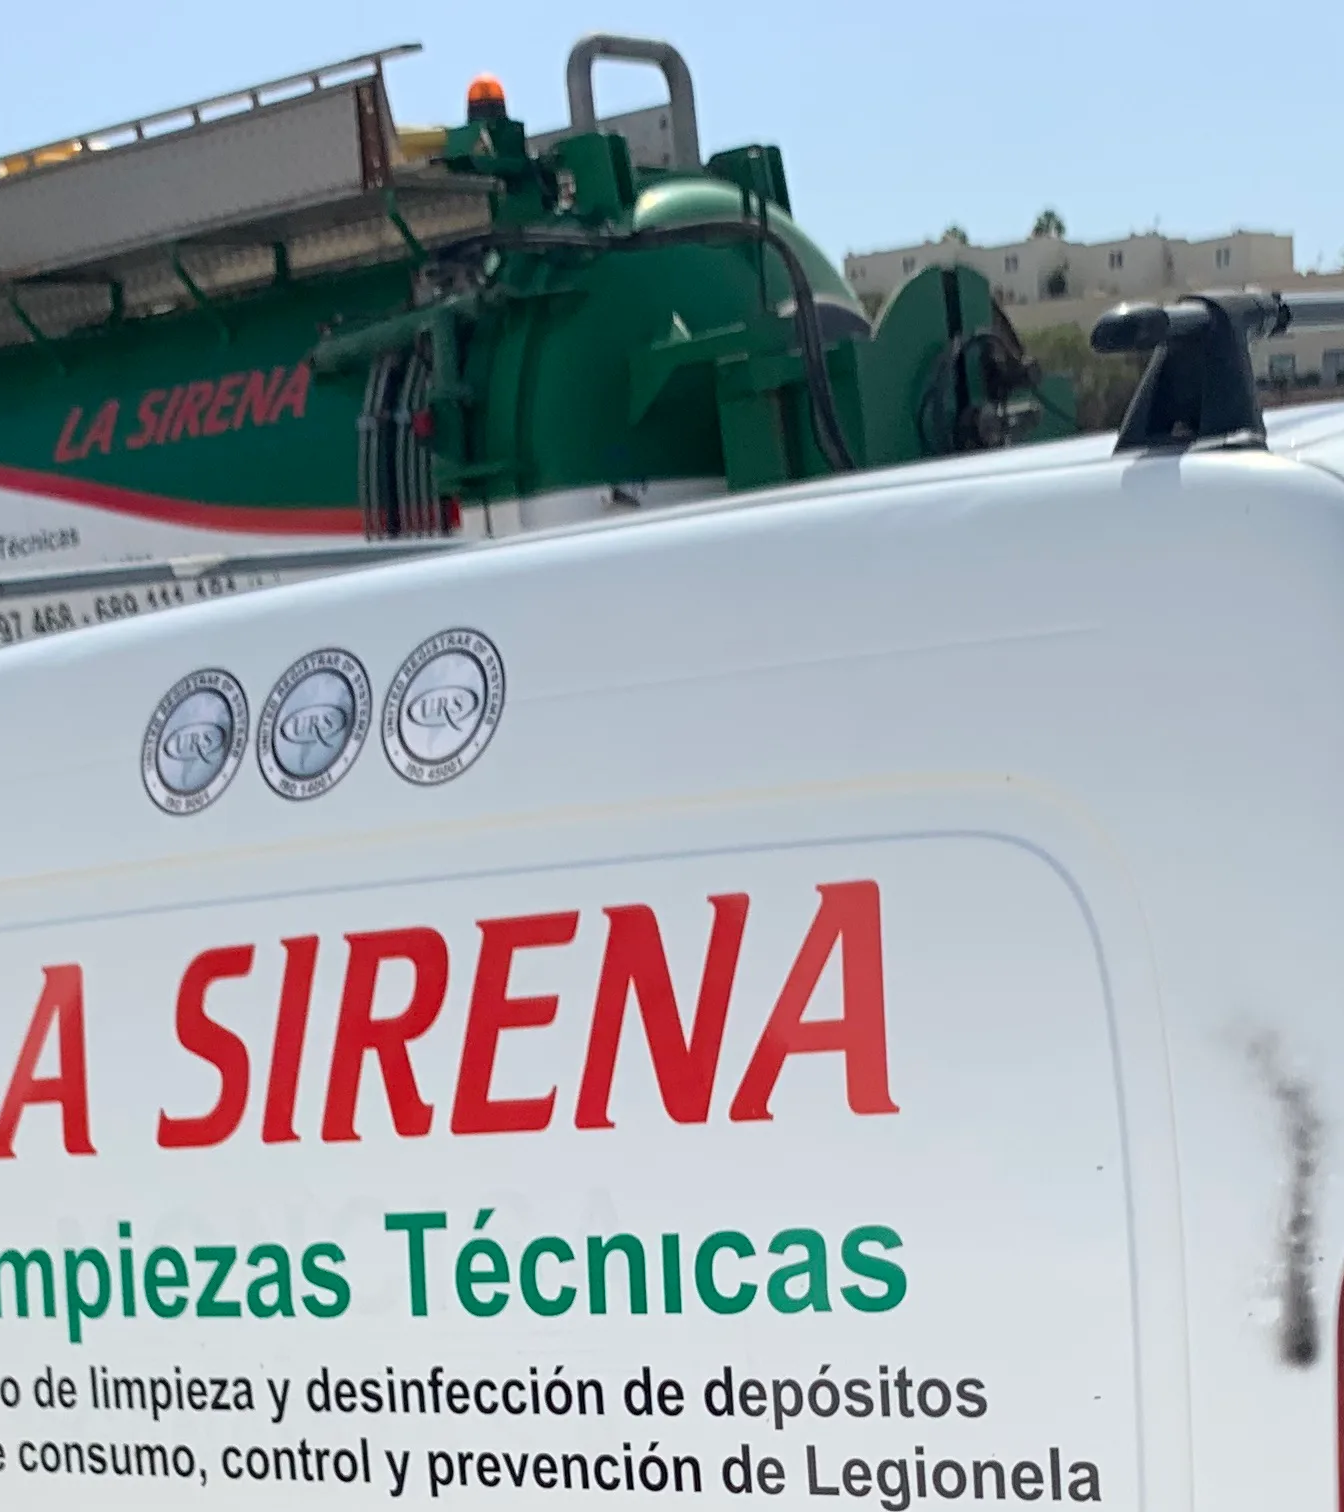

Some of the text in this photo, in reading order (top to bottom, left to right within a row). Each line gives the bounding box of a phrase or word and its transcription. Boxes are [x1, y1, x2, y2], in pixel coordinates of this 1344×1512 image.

[55, 362, 310, 463] LA SIRENA
[175, 731, 213, 763] URS
[292, 715, 334, 746] URS
[421, 696, 463, 731] URS
[155, 878, 902, 1152] SIRENA
[33, 1364, 78, 1410] de
[90, 1364, 256, 1422] limpieza
[267, 1374, 291, 1424] y
[307, 1364, 606, 1417] desinfección
[623, 1366, 685, 1417] de
[703, 1363, 989, 1430] depósitos
[18, 1439, 208, 1487] consumo,
[222, 1436, 372, 1483] control
[386, 1448, 411, 1497] y
[428, 1441, 703, 1498] prevención
[721, 1443, 786, 1495] de
[806, 1443, 1102, 1512] Legionela
